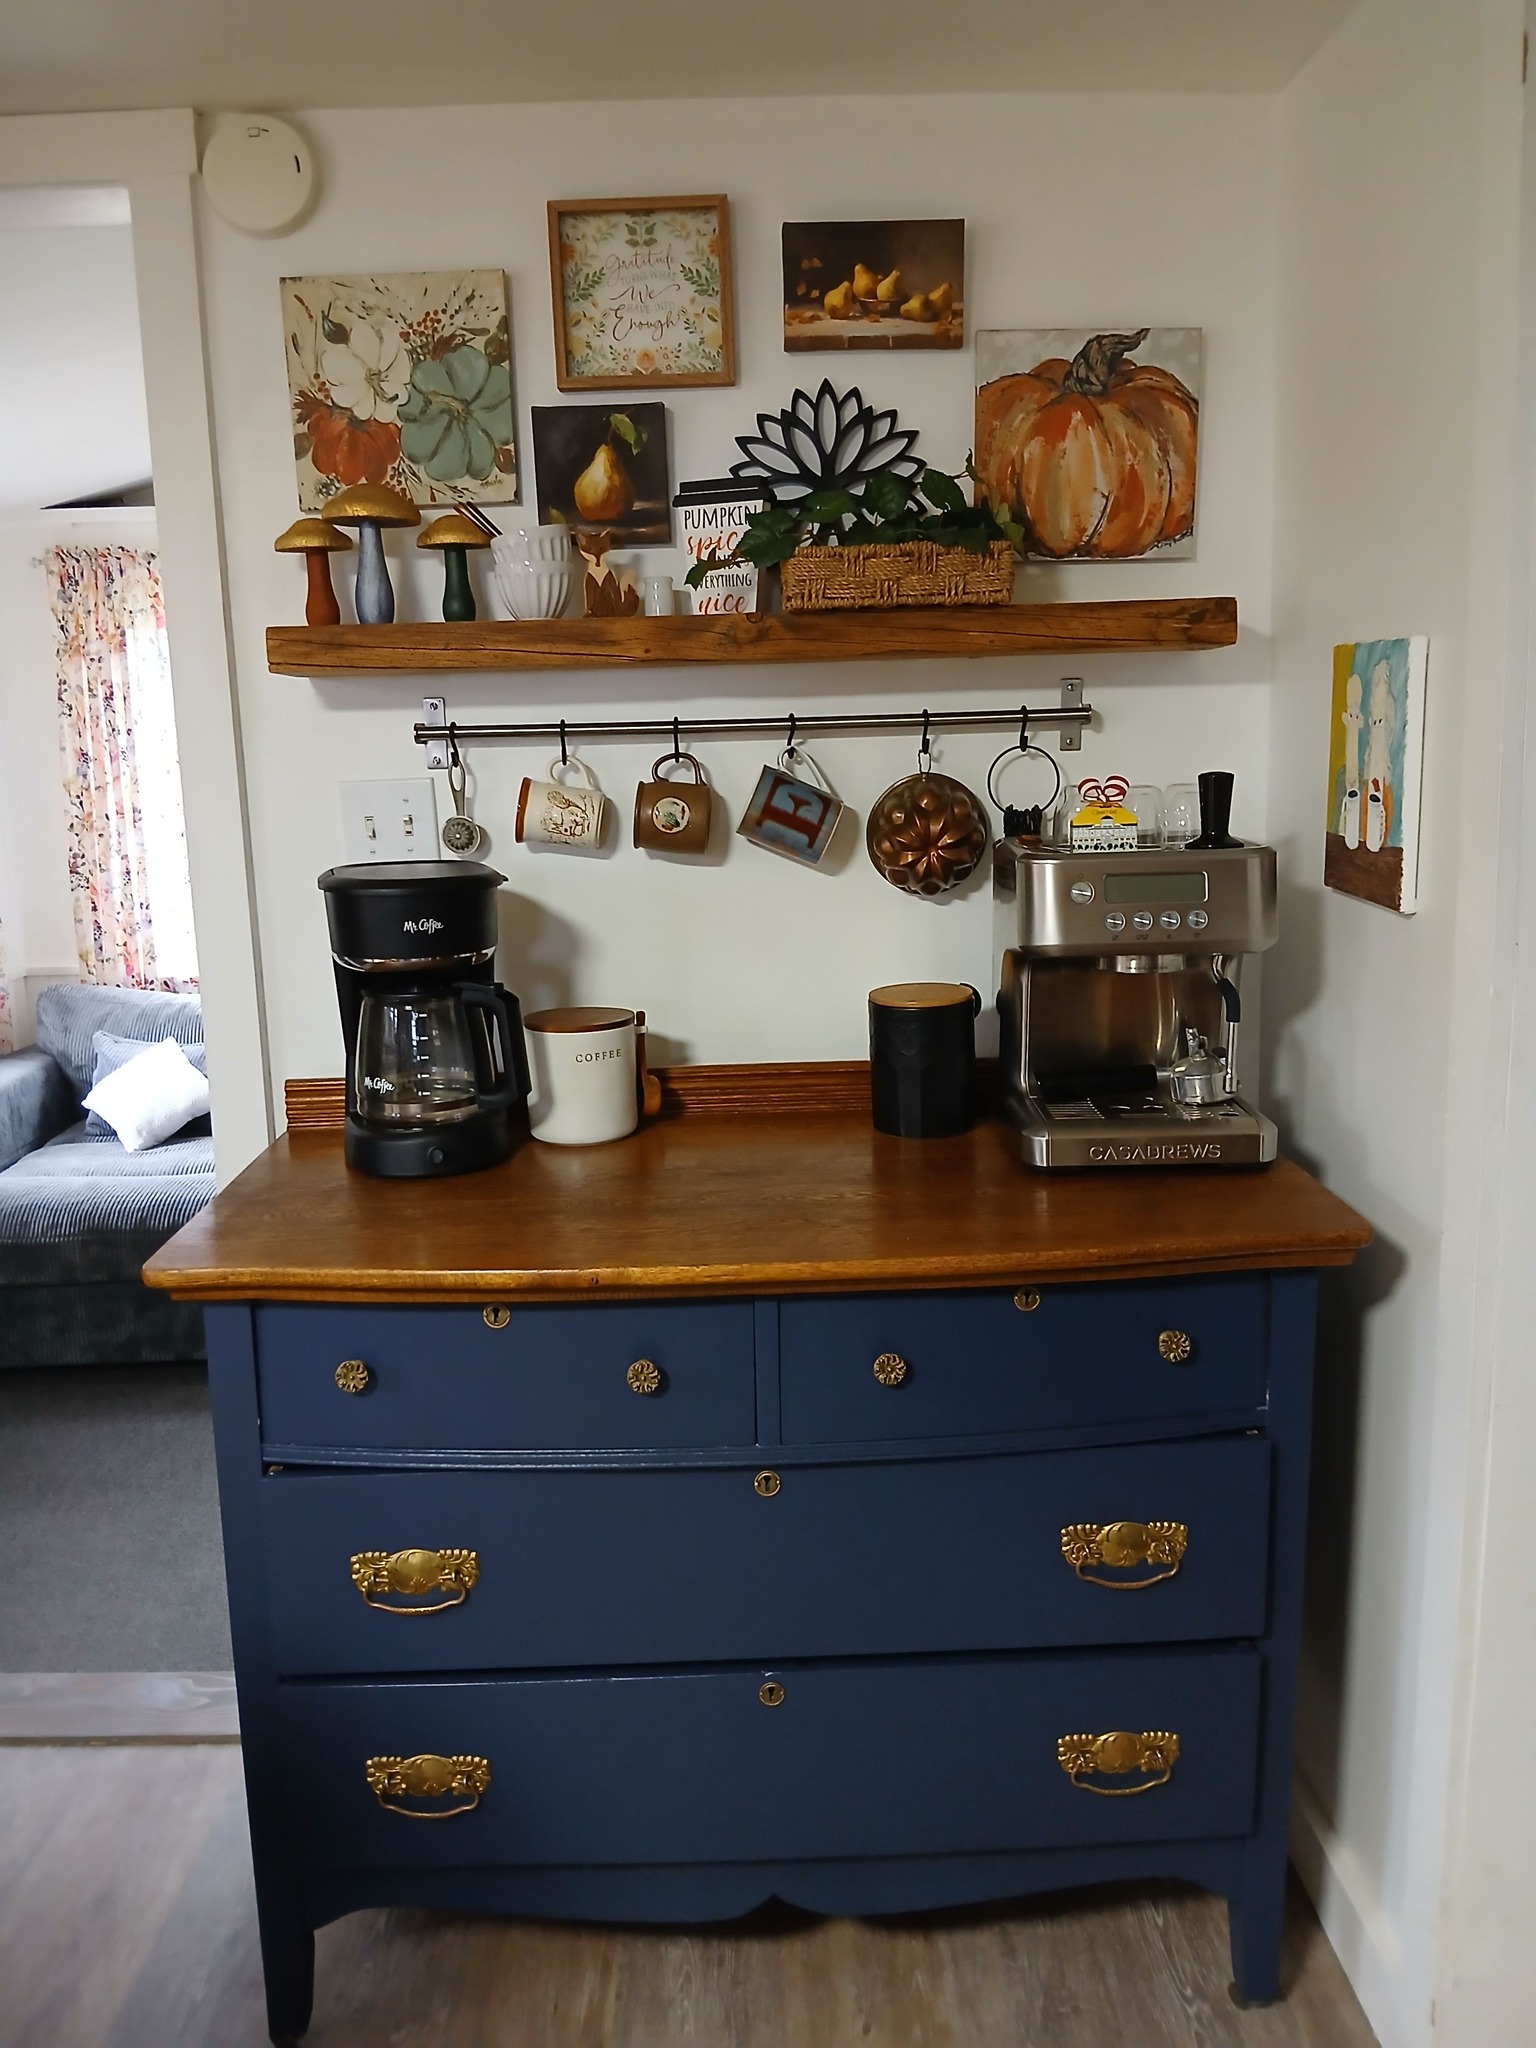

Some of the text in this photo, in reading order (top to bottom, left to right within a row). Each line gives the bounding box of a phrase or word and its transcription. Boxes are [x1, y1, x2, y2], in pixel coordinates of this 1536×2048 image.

[621, 270, 677, 285] TURNS WHAT
[609, 283, 681, 304] We
[626, 301, 676, 314] HAVE INTO
[609, 303, 681, 341] Enough
[687, 530, 739, 561] spic
[698, 593, 748, 615] nice
[418, 918, 444, 935] Coffee
[575, 1048, 622, 1063] COFFEE
[373, 1077, 396, 1094] Coffee
